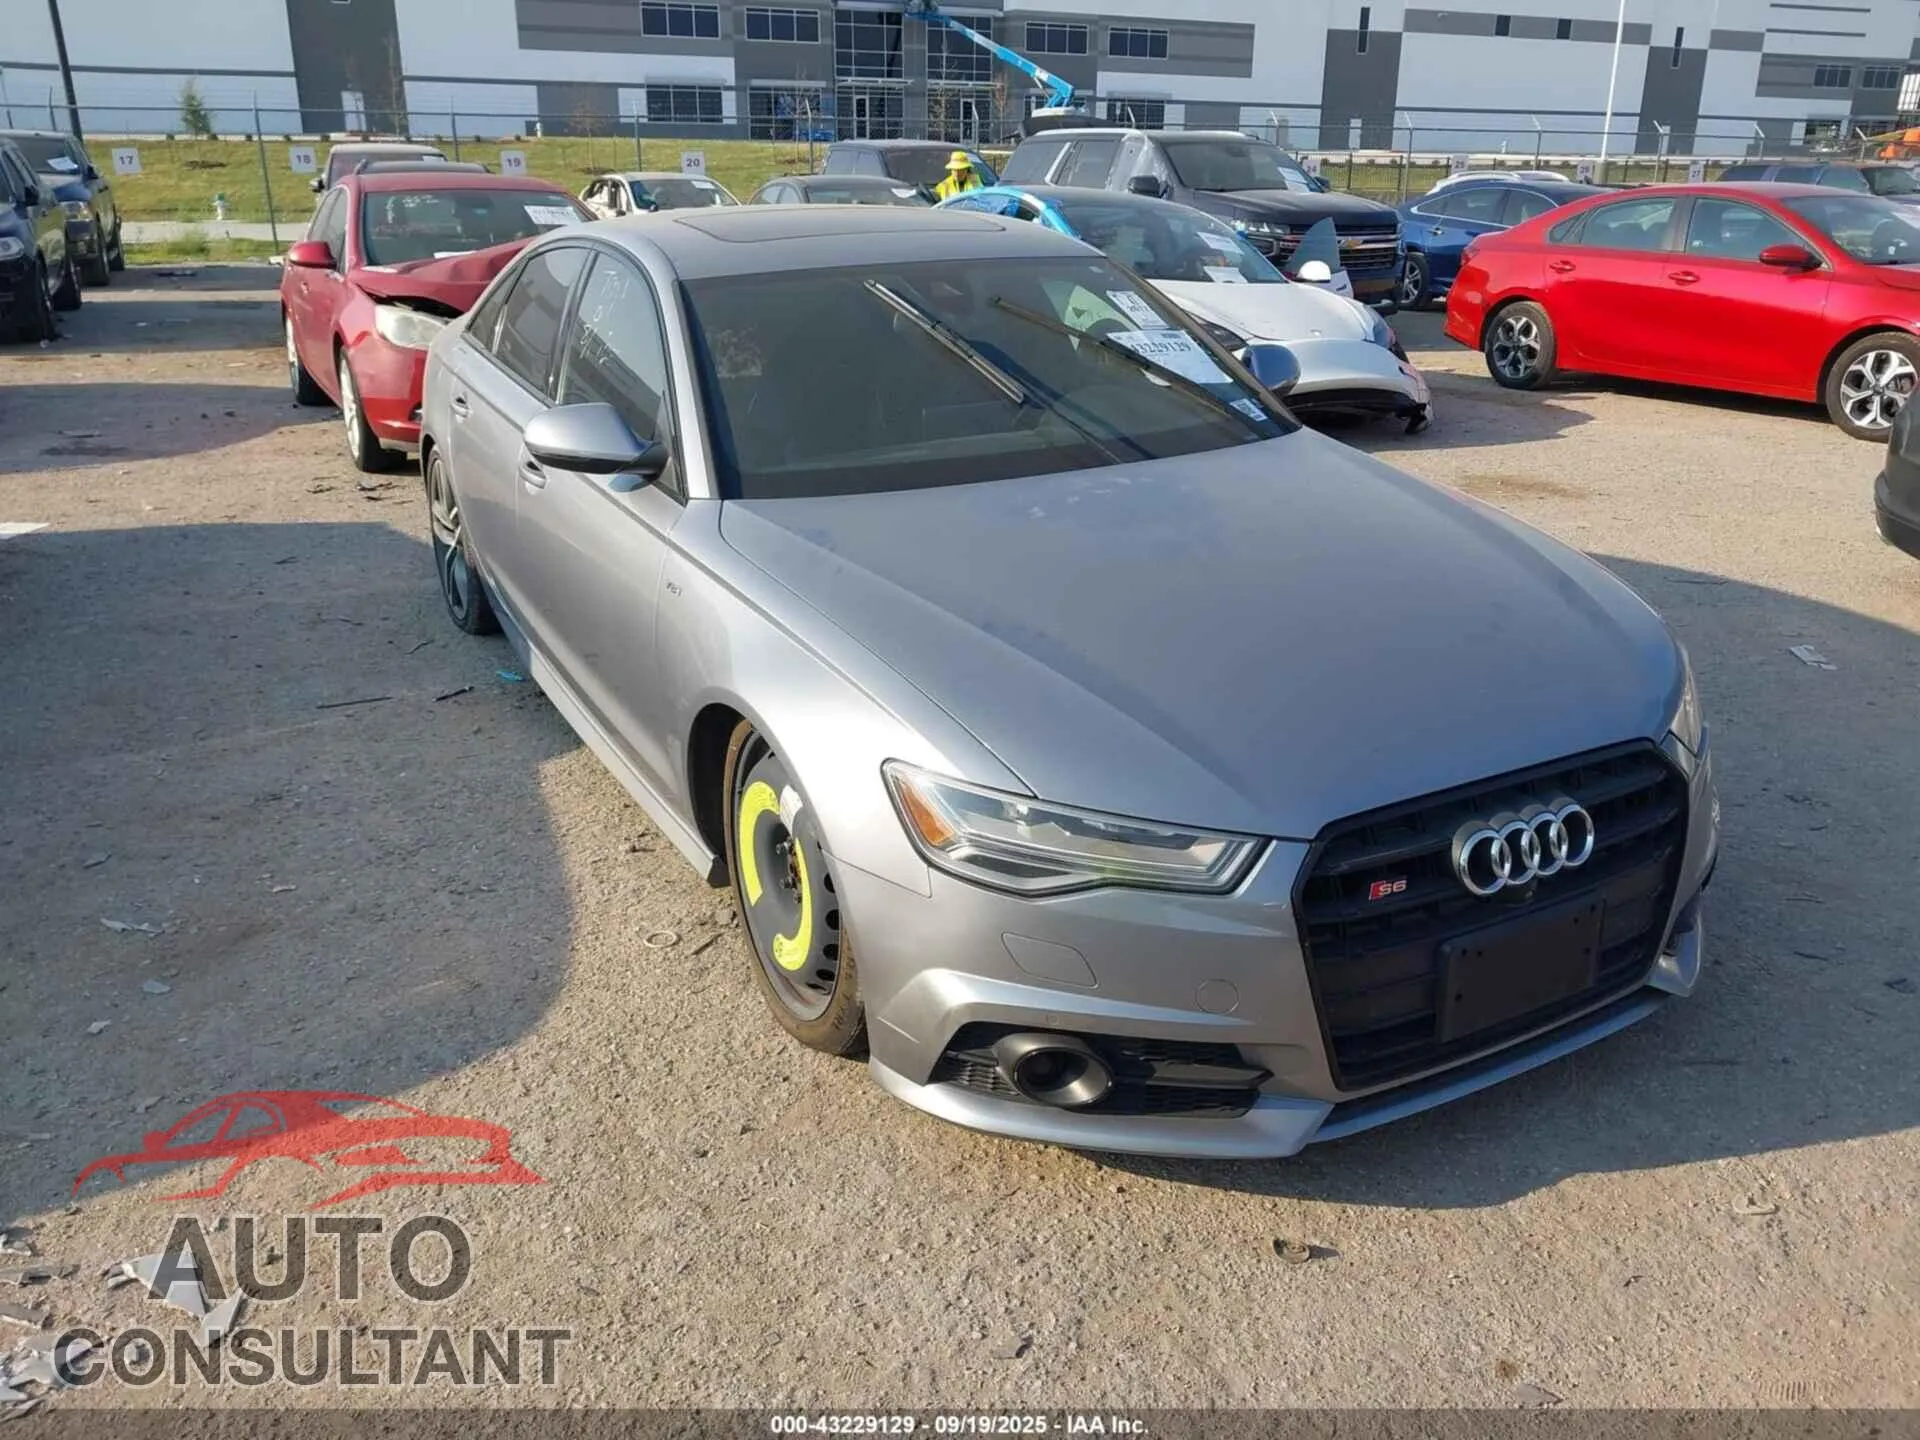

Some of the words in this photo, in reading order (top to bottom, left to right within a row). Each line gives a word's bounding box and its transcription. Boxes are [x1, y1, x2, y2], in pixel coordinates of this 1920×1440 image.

[118, 154, 134, 166] 17
[296, 154, 312, 165] 18
[505, 157, 521, 167] 19
[686, 158, 700, 168] 20
